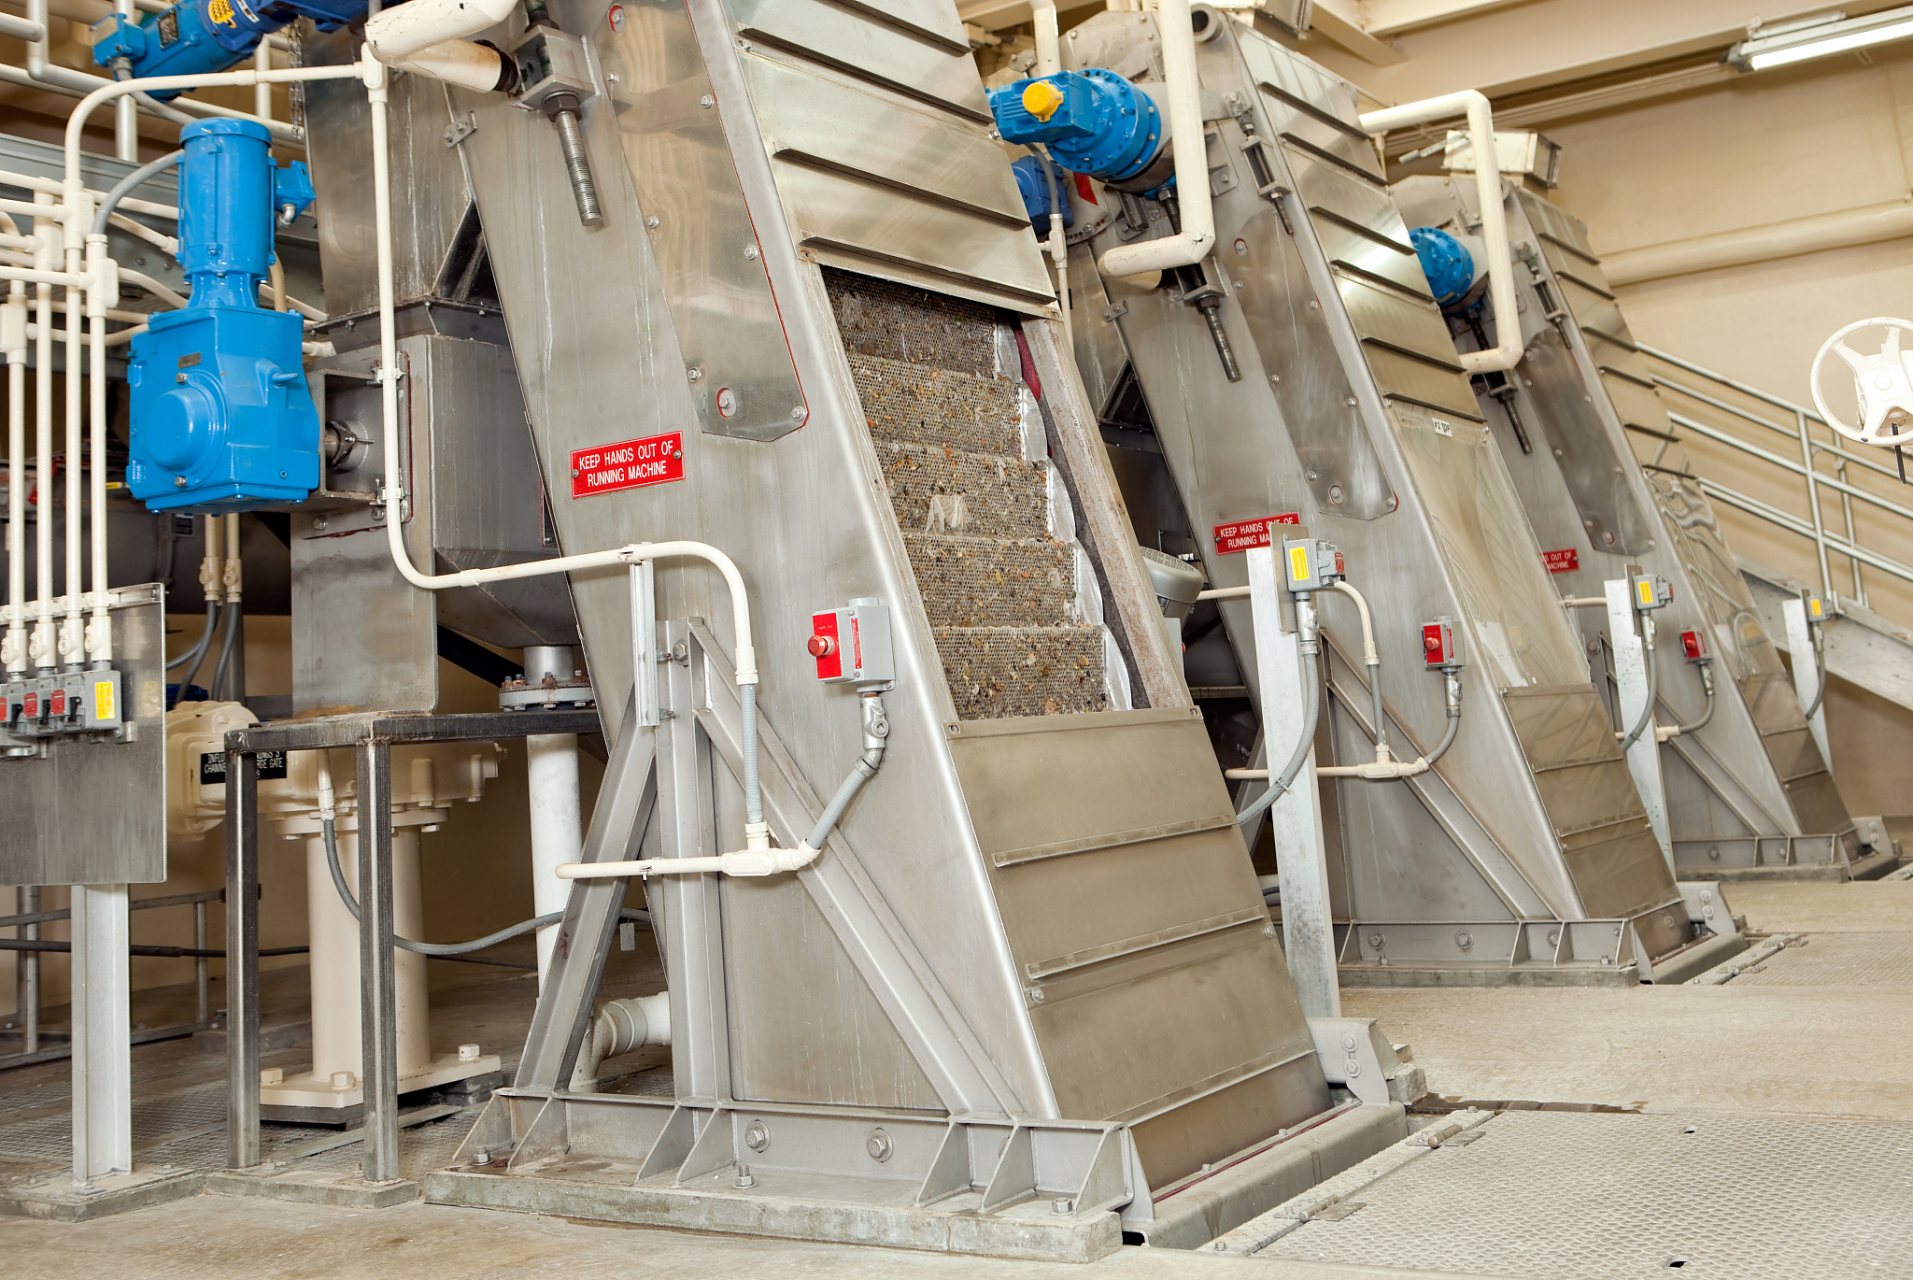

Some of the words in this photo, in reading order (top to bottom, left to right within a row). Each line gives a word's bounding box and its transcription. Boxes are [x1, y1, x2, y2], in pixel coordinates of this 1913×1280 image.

[579, 454, 600, 471] KEEP
[604, 447, 634, 466] HANDS
[638, 443, 657, 460] OUT
[661, 440, 674, 456] OF
[587, 468, 625, 487] RUNNING
[628, 460, 667, 480] MACHINE
[1220, 527, 1237, 538] KEEP
[1240, 522, 1264, 534] HANDS
[1228, 536, 1257, 549] RUNNING
[1550, 552, 1562, 562] OUT
[1564, 551, 1572, 559] OF
[203, 762, 226, 774] CHANNE
[269, 757, 283, 769] GATE
[207, 753, 226, 764] INFLU
